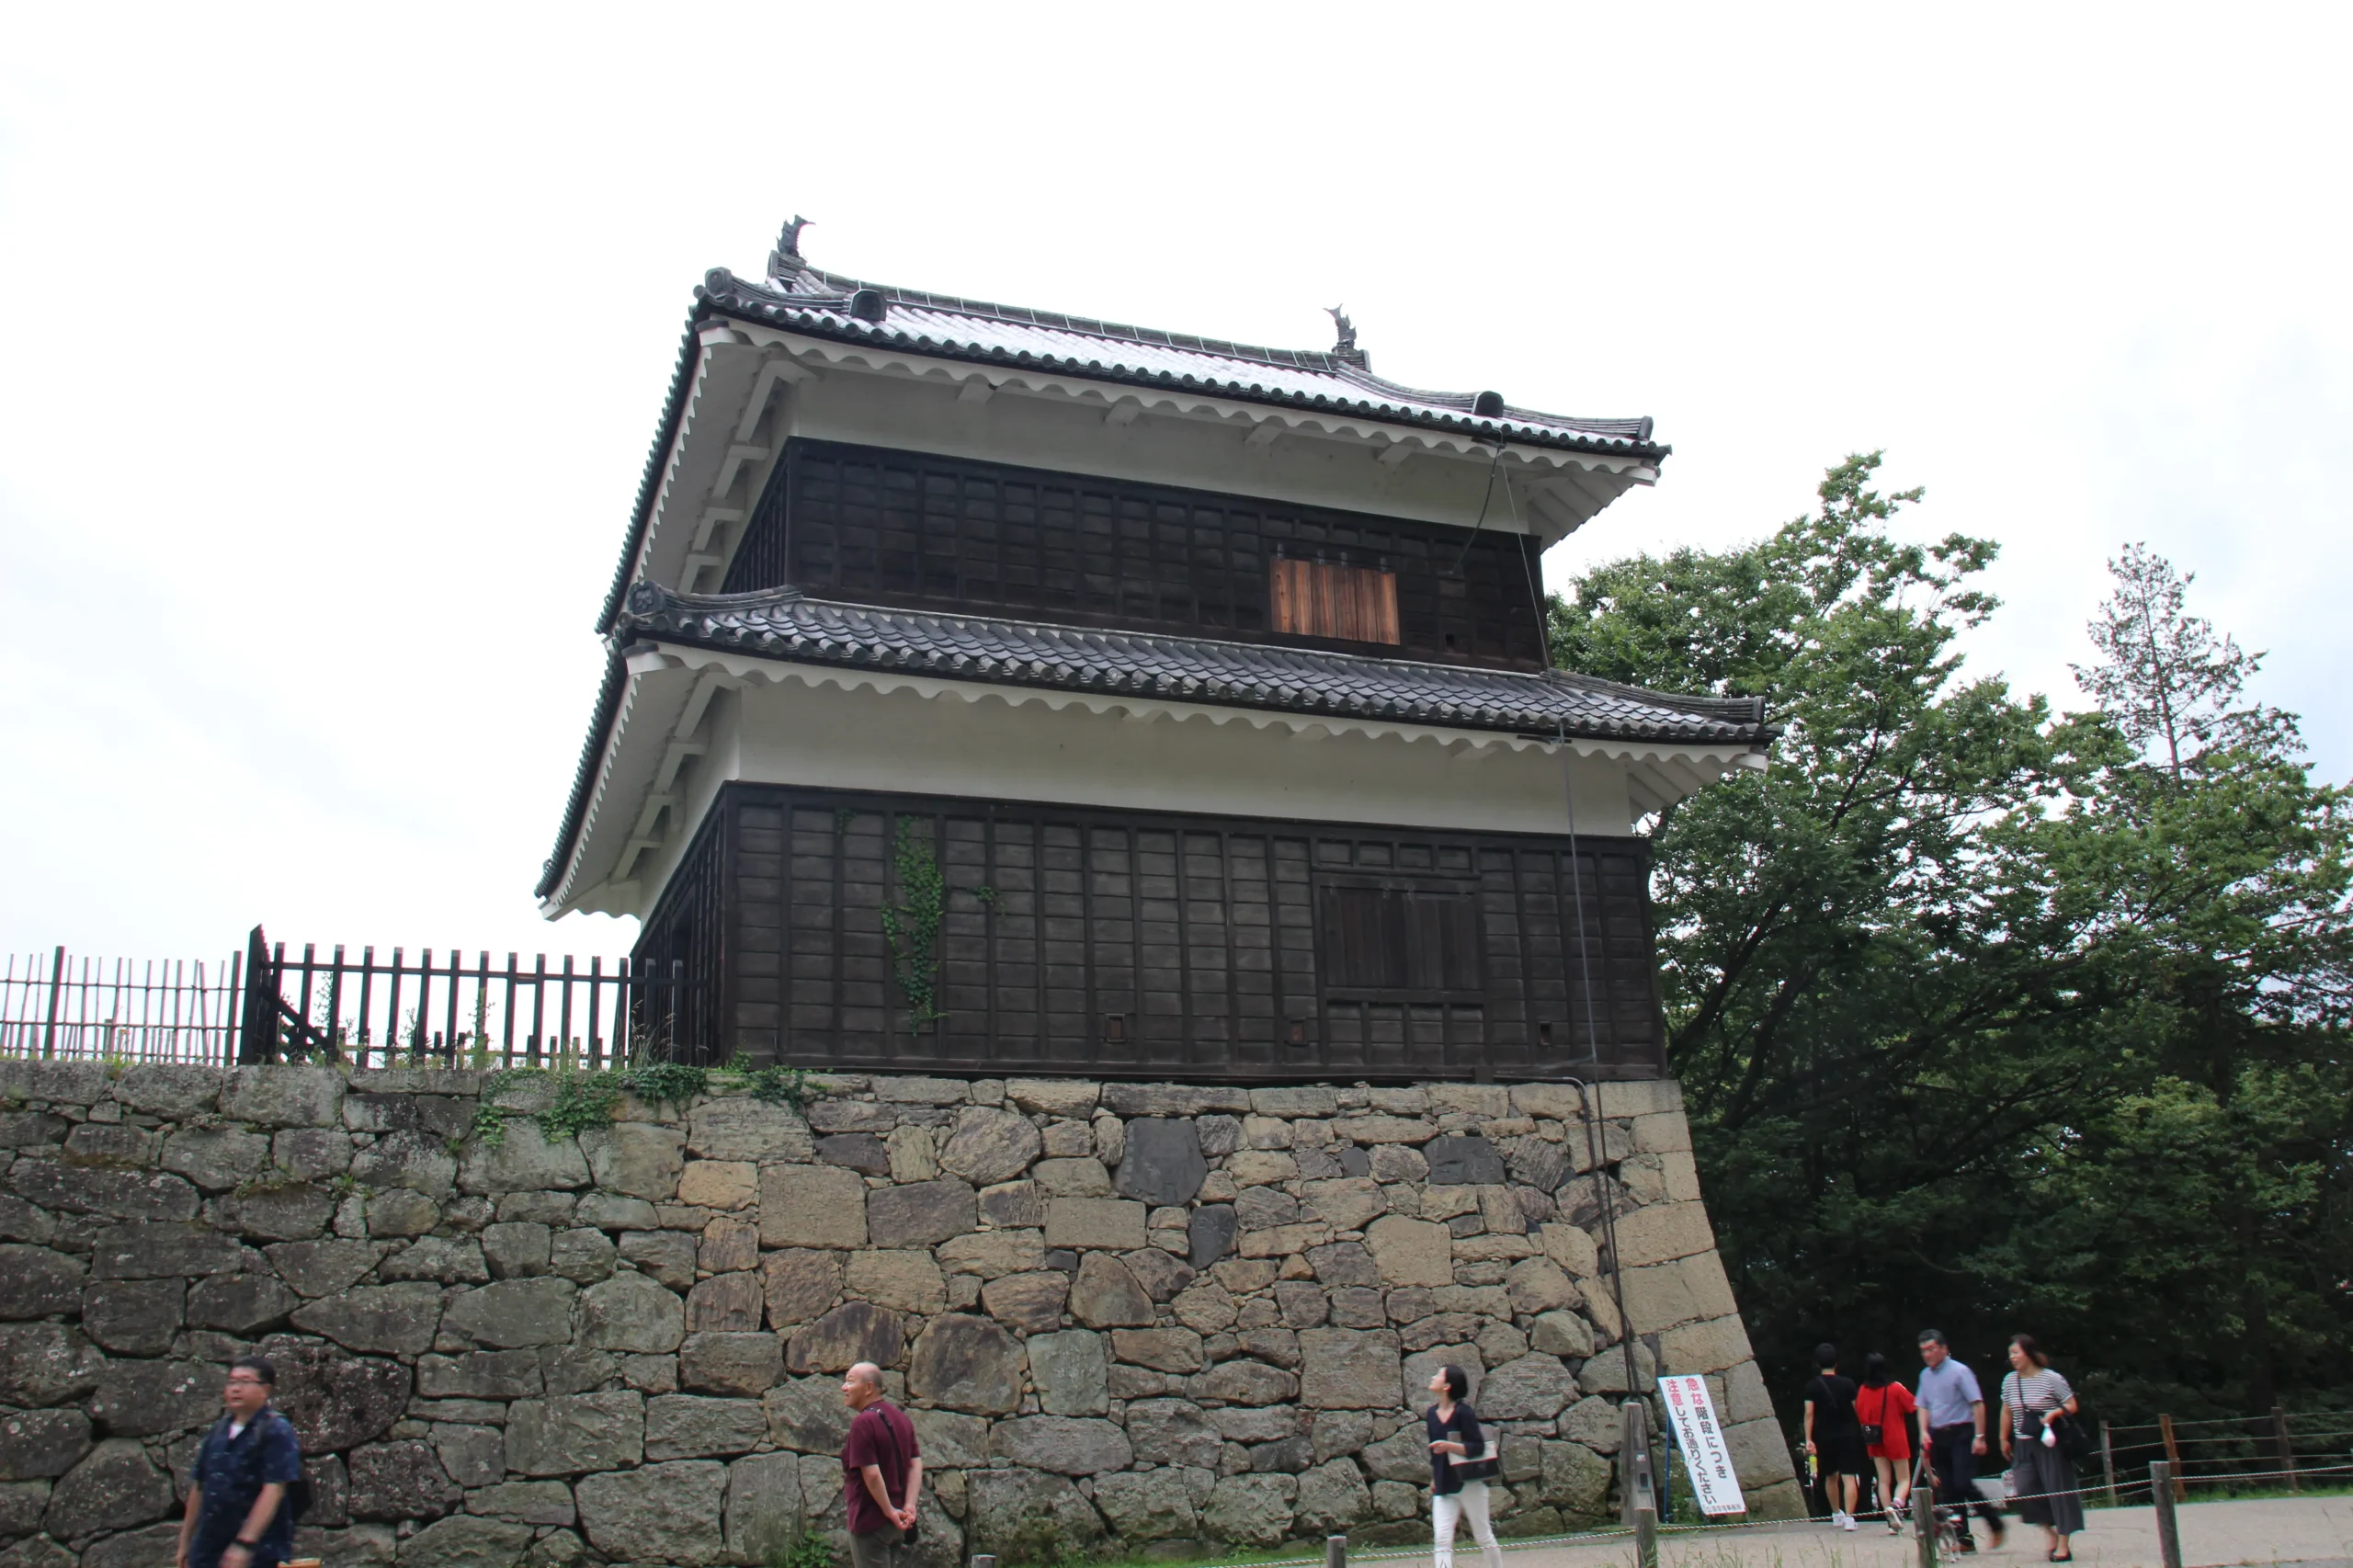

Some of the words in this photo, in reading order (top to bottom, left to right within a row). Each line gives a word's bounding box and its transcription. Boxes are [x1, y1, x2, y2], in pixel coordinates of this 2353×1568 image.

[1665, 1380, 1717, 1505] 注意してお通りください
[1685, 1378, 1727, 1479] 急な階段につき
